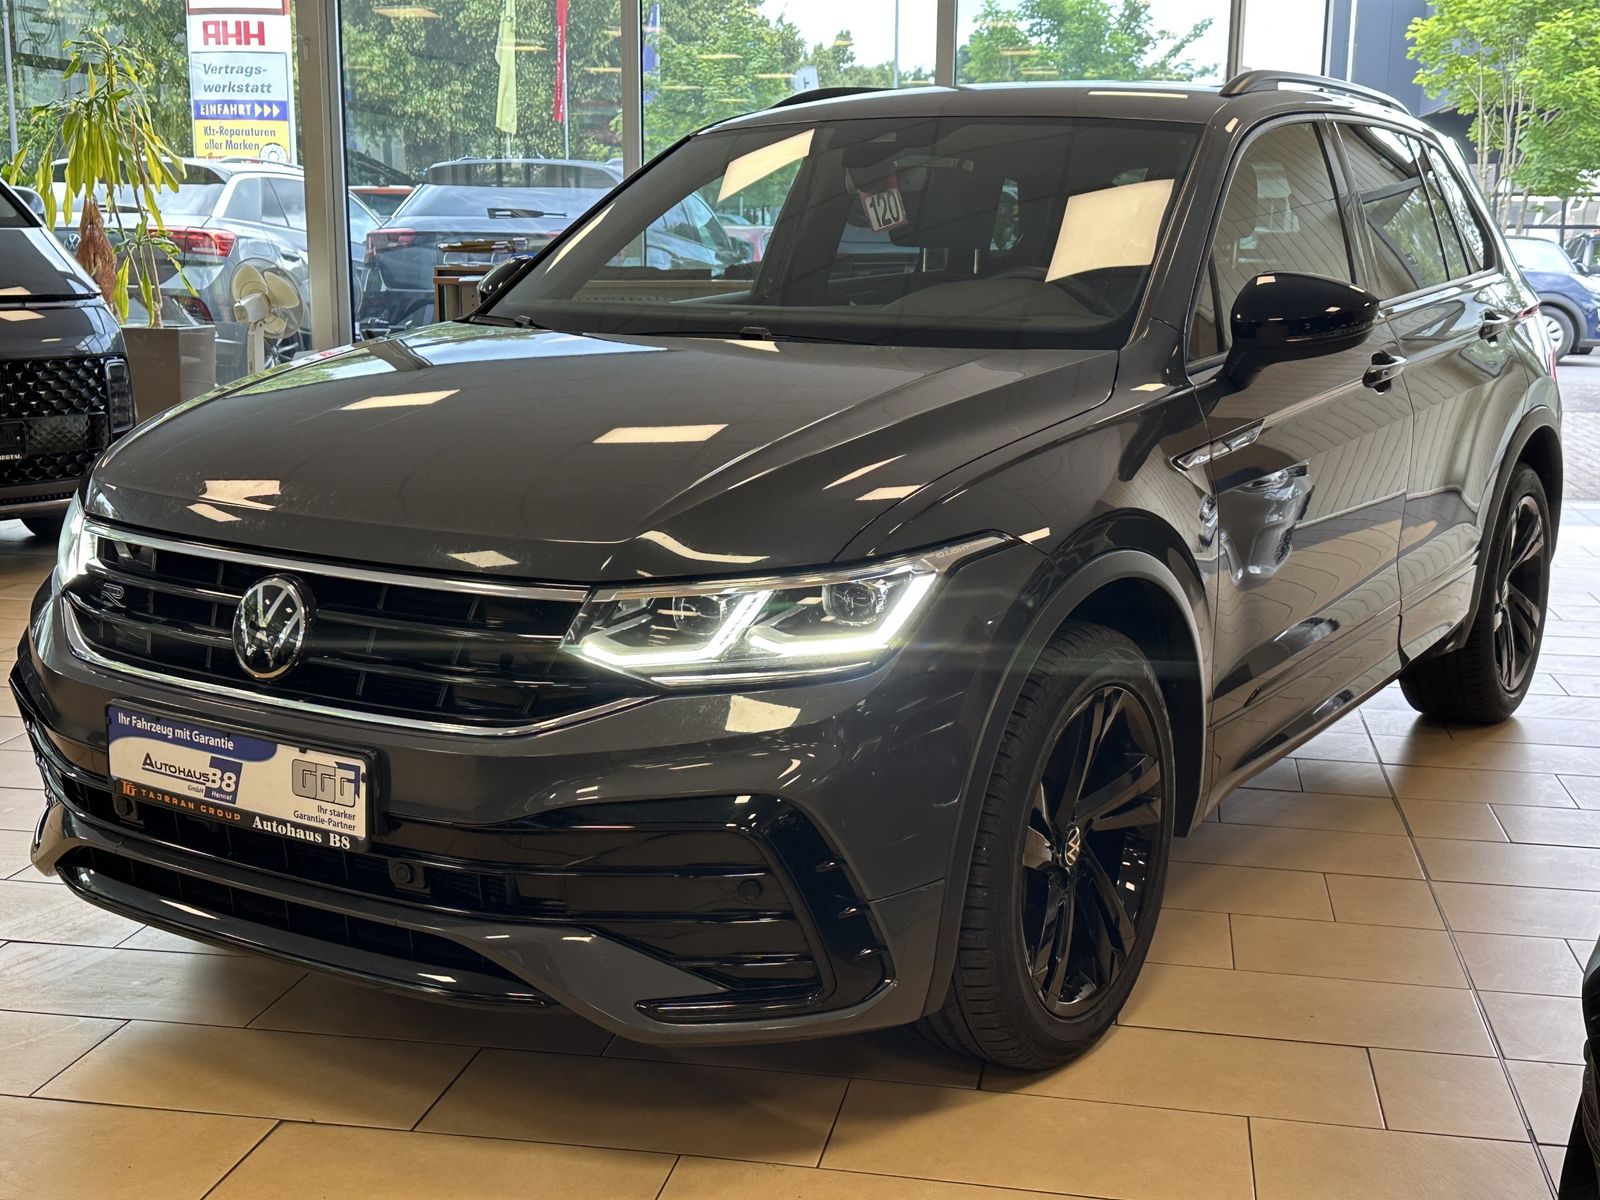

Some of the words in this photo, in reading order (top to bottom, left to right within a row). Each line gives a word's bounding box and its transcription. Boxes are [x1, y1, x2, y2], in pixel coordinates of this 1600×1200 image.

[202, 20, 266, 46] AHH
[203, 63, 267, 77] Vertrags-
[203, 81, 272, 94] werkstatt
[200, 103, 252, 116] EINFAHRT
[203, 125, 276, 138] Kfz-Reparaturen
[204, 140, 223, 150] aller
[225, 140, 260, 151] Marken
[869, 190, 900, 228] 120
[118, 712, 130, 725] Ihr
[131, 715, 173, 739] Fahrzeug
[174, 728, 191, 741] mit
[192, 730, 234, 750] Garantie
[187, 784, 204, 794] GmbH
[200, 804, 241, 820] GROUP
[317, 804, 328, 815] Ihr
[329, 808, 356, 821] starker
[293, 810, 356, 832] Garantie-Partner
[252, 815, 323, 844] Autohaus
[329, 832, 351, 850] B8
